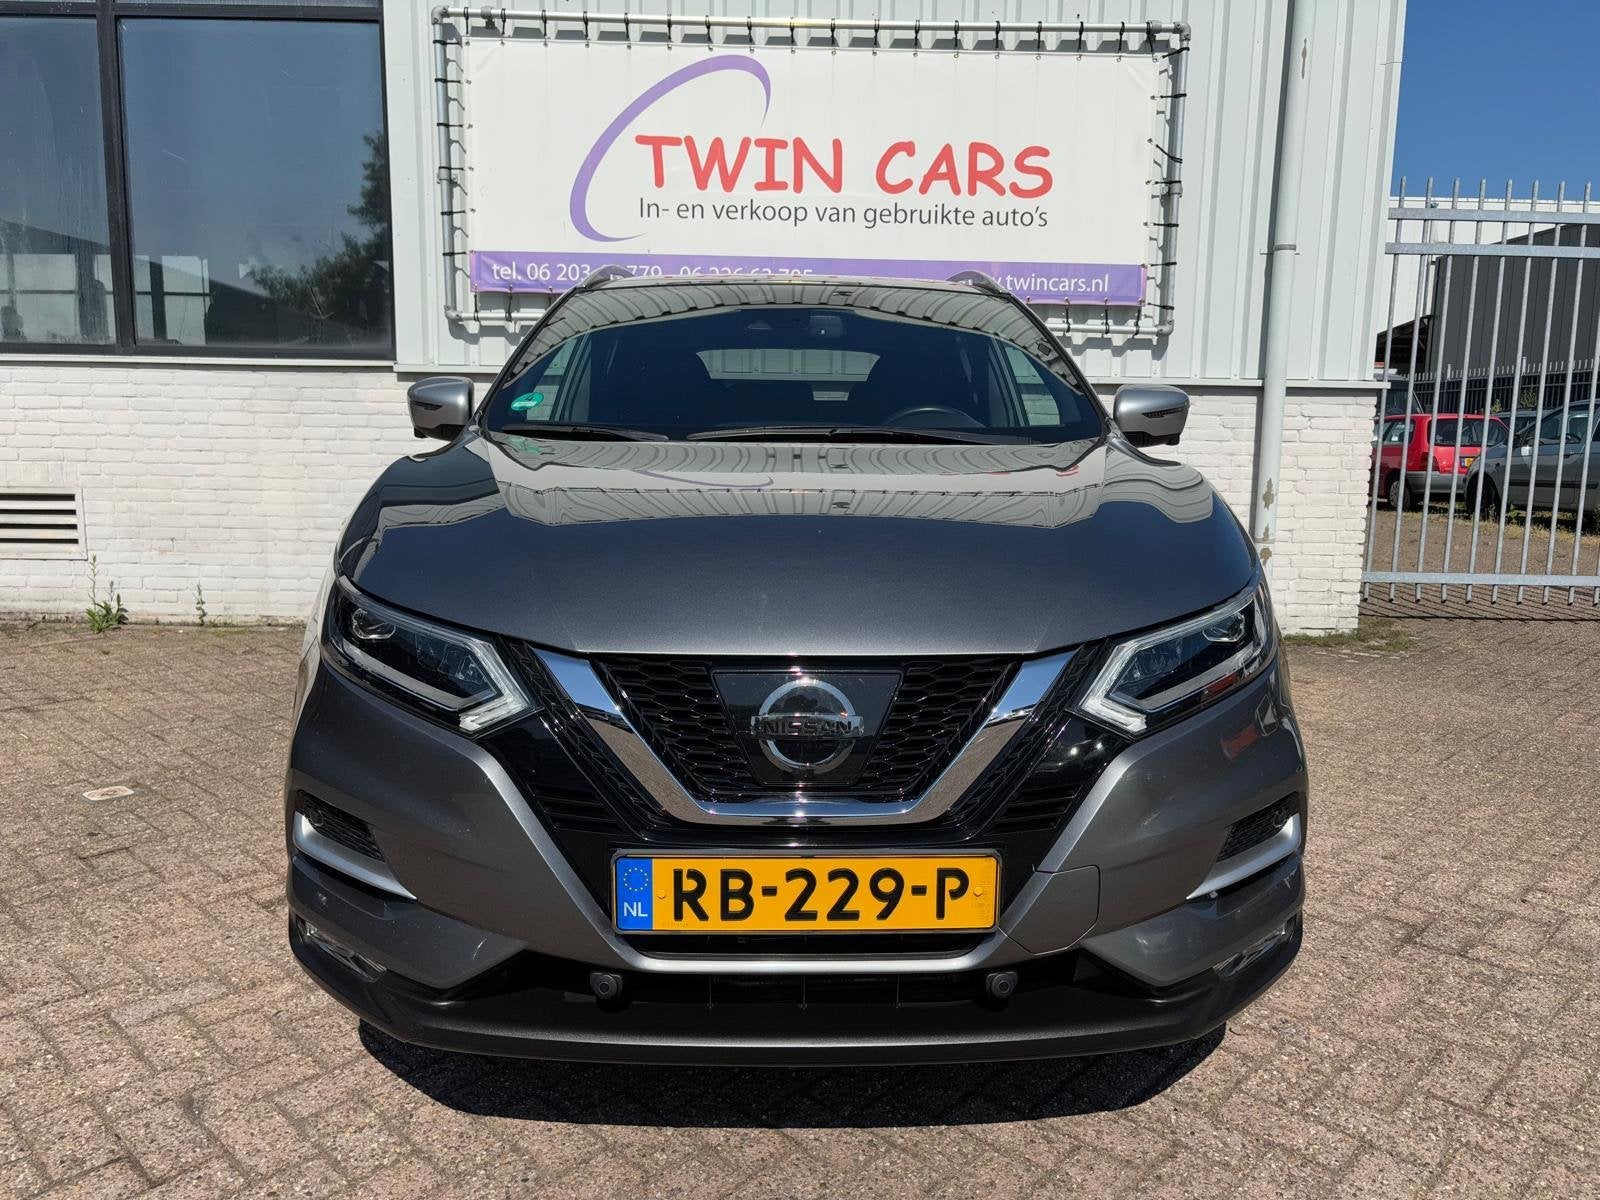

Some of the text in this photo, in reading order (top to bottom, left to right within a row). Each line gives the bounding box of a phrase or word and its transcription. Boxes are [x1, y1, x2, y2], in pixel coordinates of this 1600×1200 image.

[635, 134, 1053, 199] TWIN CARS
[639, 197, 1048, 229] In- en verkoop van gebruikte auto's
[491, 261, 522, 280] tel.
[526, 263, 550, 281] 06
[556, 263, 591, 281] 203
[763, 719, 852, 736] NISSAN
[673, 867, 970, 922] RB-229-P
[623, 901, 648, 917] NL
